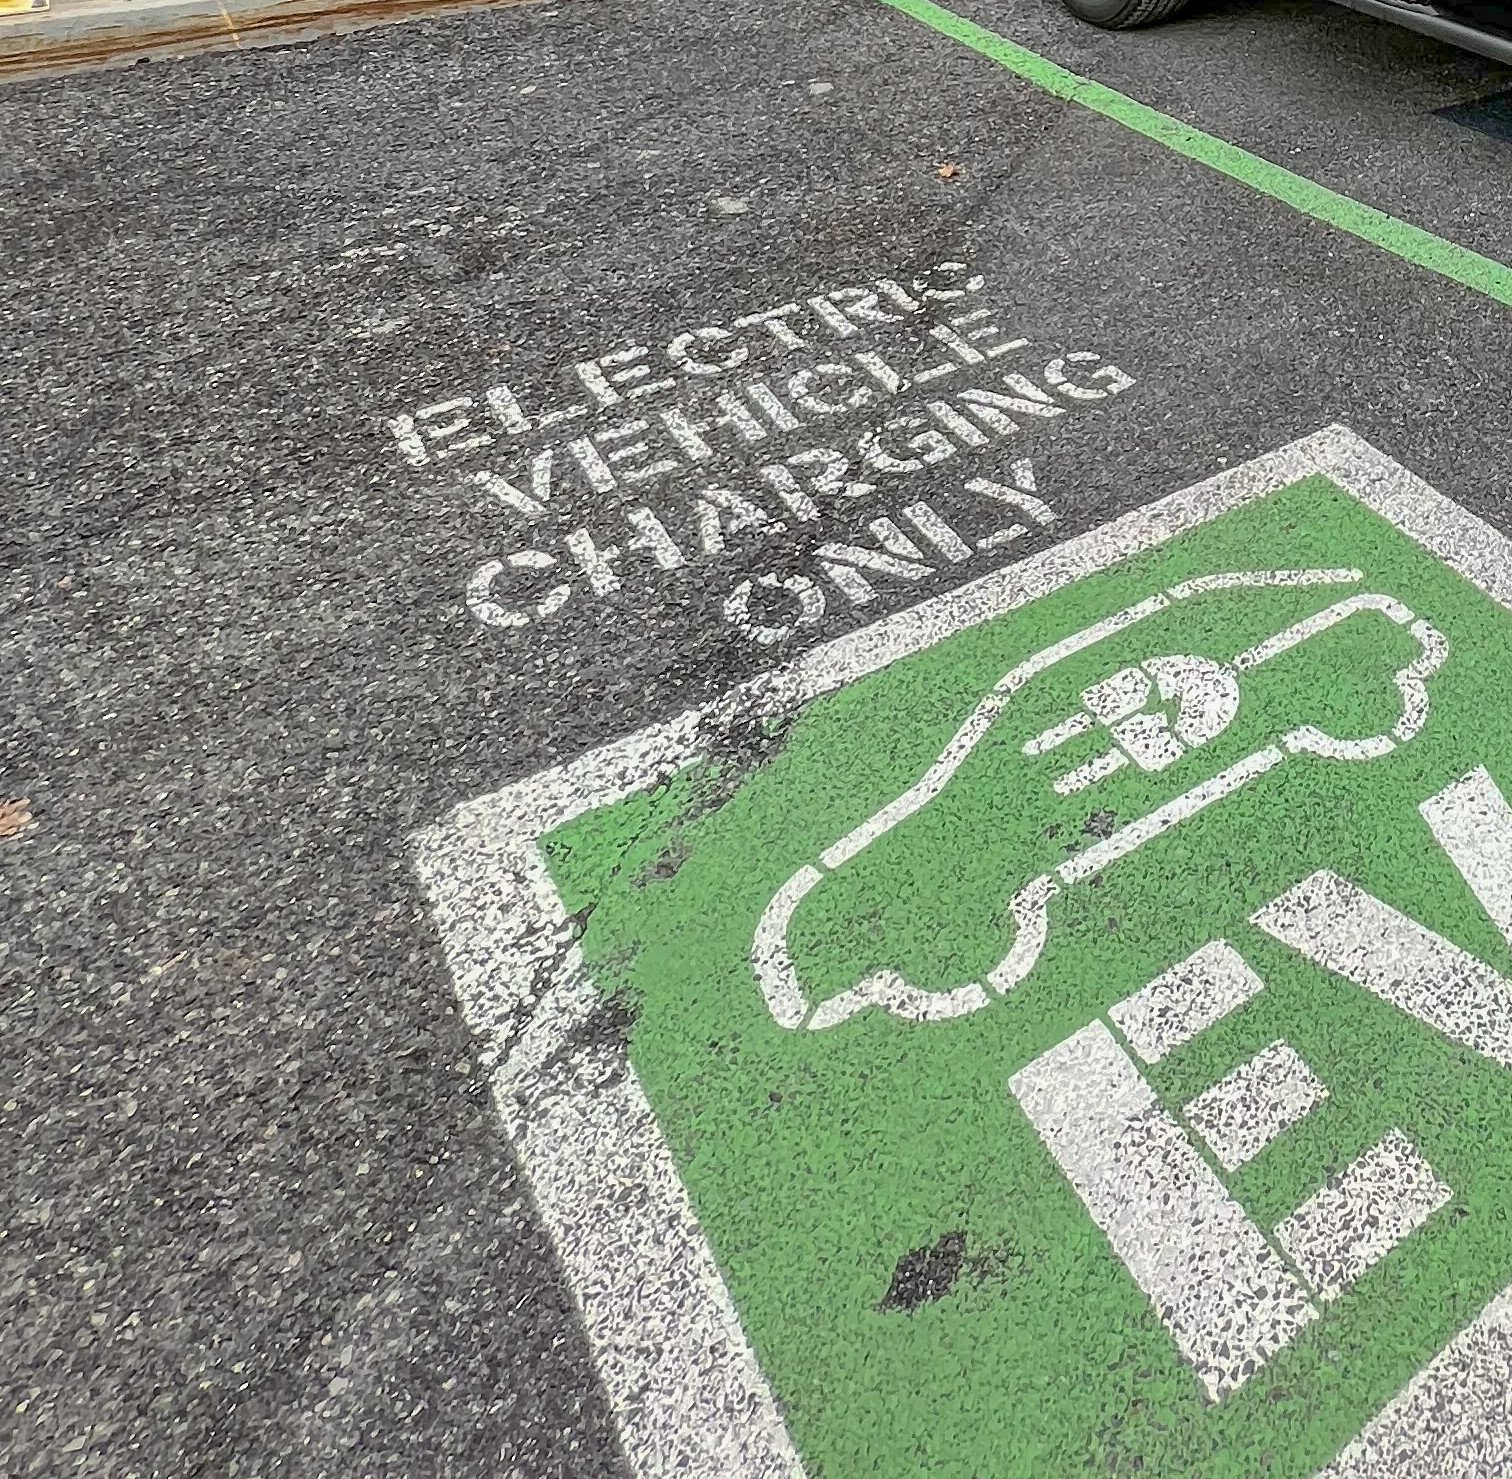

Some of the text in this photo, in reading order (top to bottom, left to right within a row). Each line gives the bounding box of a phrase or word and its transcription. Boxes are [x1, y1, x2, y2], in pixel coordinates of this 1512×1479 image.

[387, 261, 986, 466] ELECTRIC
[466, 308, 1031, 516] VEHICLE
[466, 351, 1138, 626] CHARGING
[722, 457, 1060, 646] ONLY
